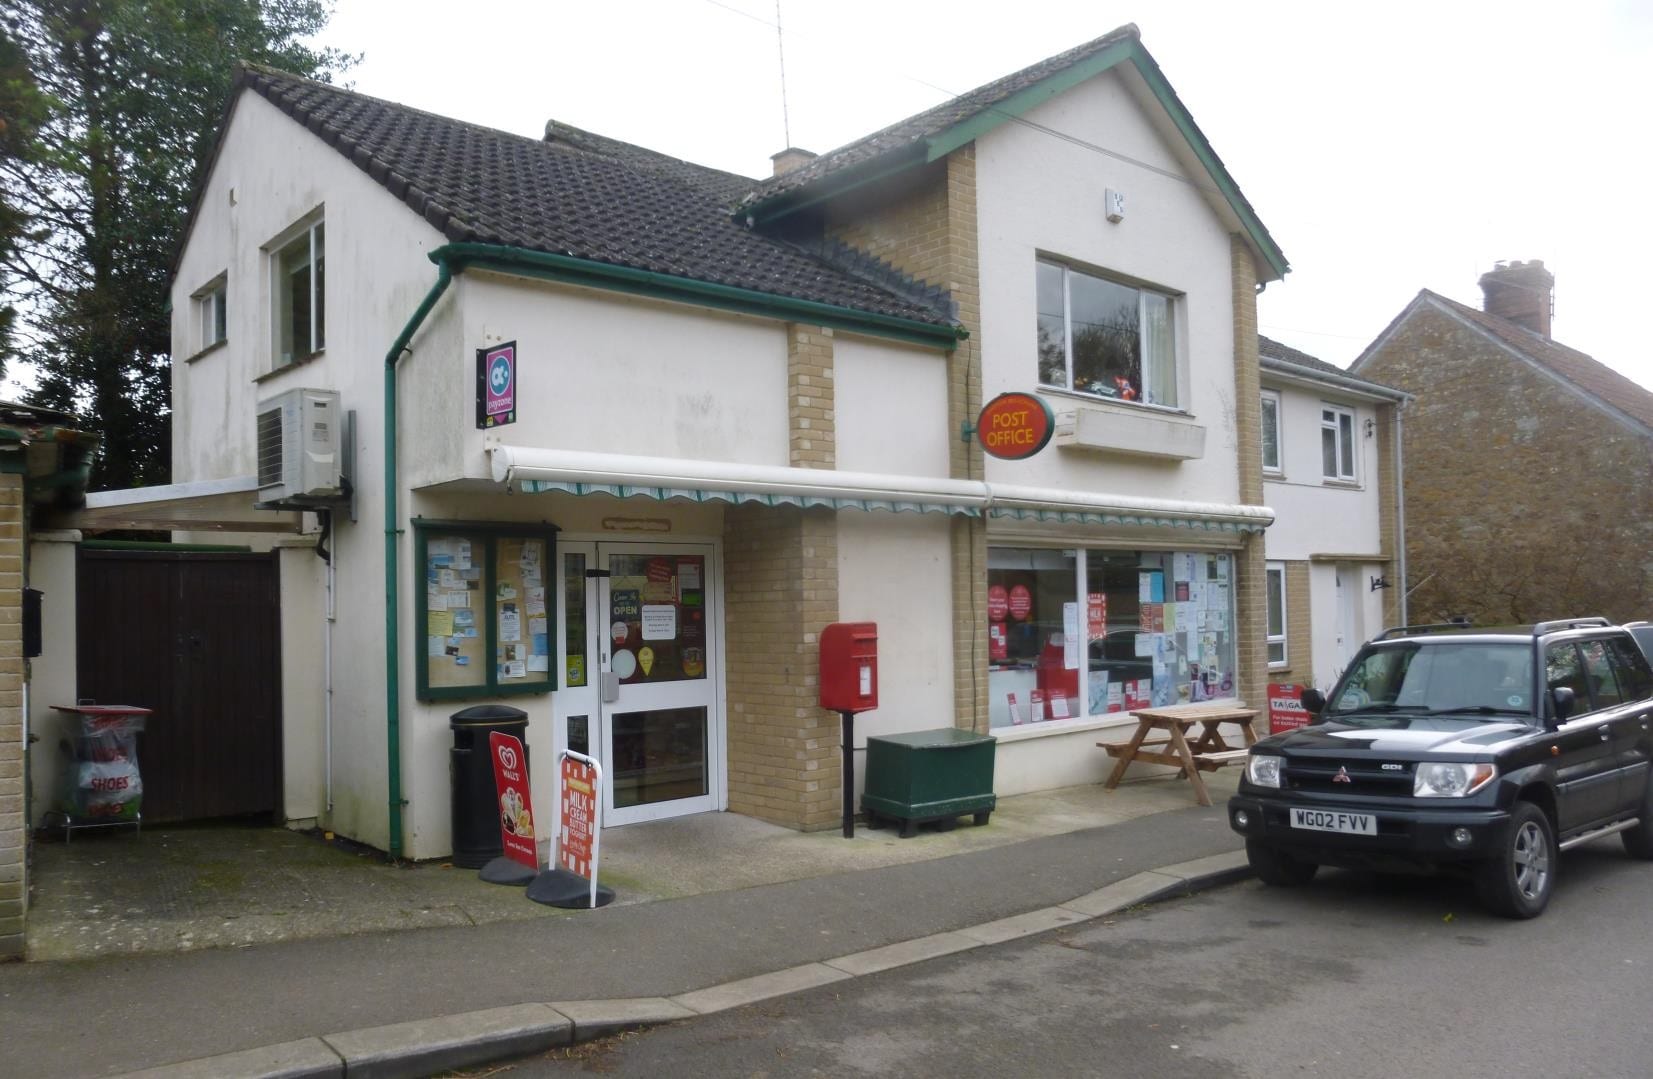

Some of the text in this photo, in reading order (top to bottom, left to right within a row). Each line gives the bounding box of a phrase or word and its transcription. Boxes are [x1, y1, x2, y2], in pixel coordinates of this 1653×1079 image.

[993, 411, 1029, 429] POST
[987, 429, 1034, 447] OFFICE
[614, 605, 638, 615] OPEN
[91, 776, 129, 791] SHOES
[569, 790, 587, 811] MILK
[569, 807, 587, 823] CREAM
[1296, 809, 1368, 831] WG02 FVV
[569, 817, 587, 833] BUTTER
